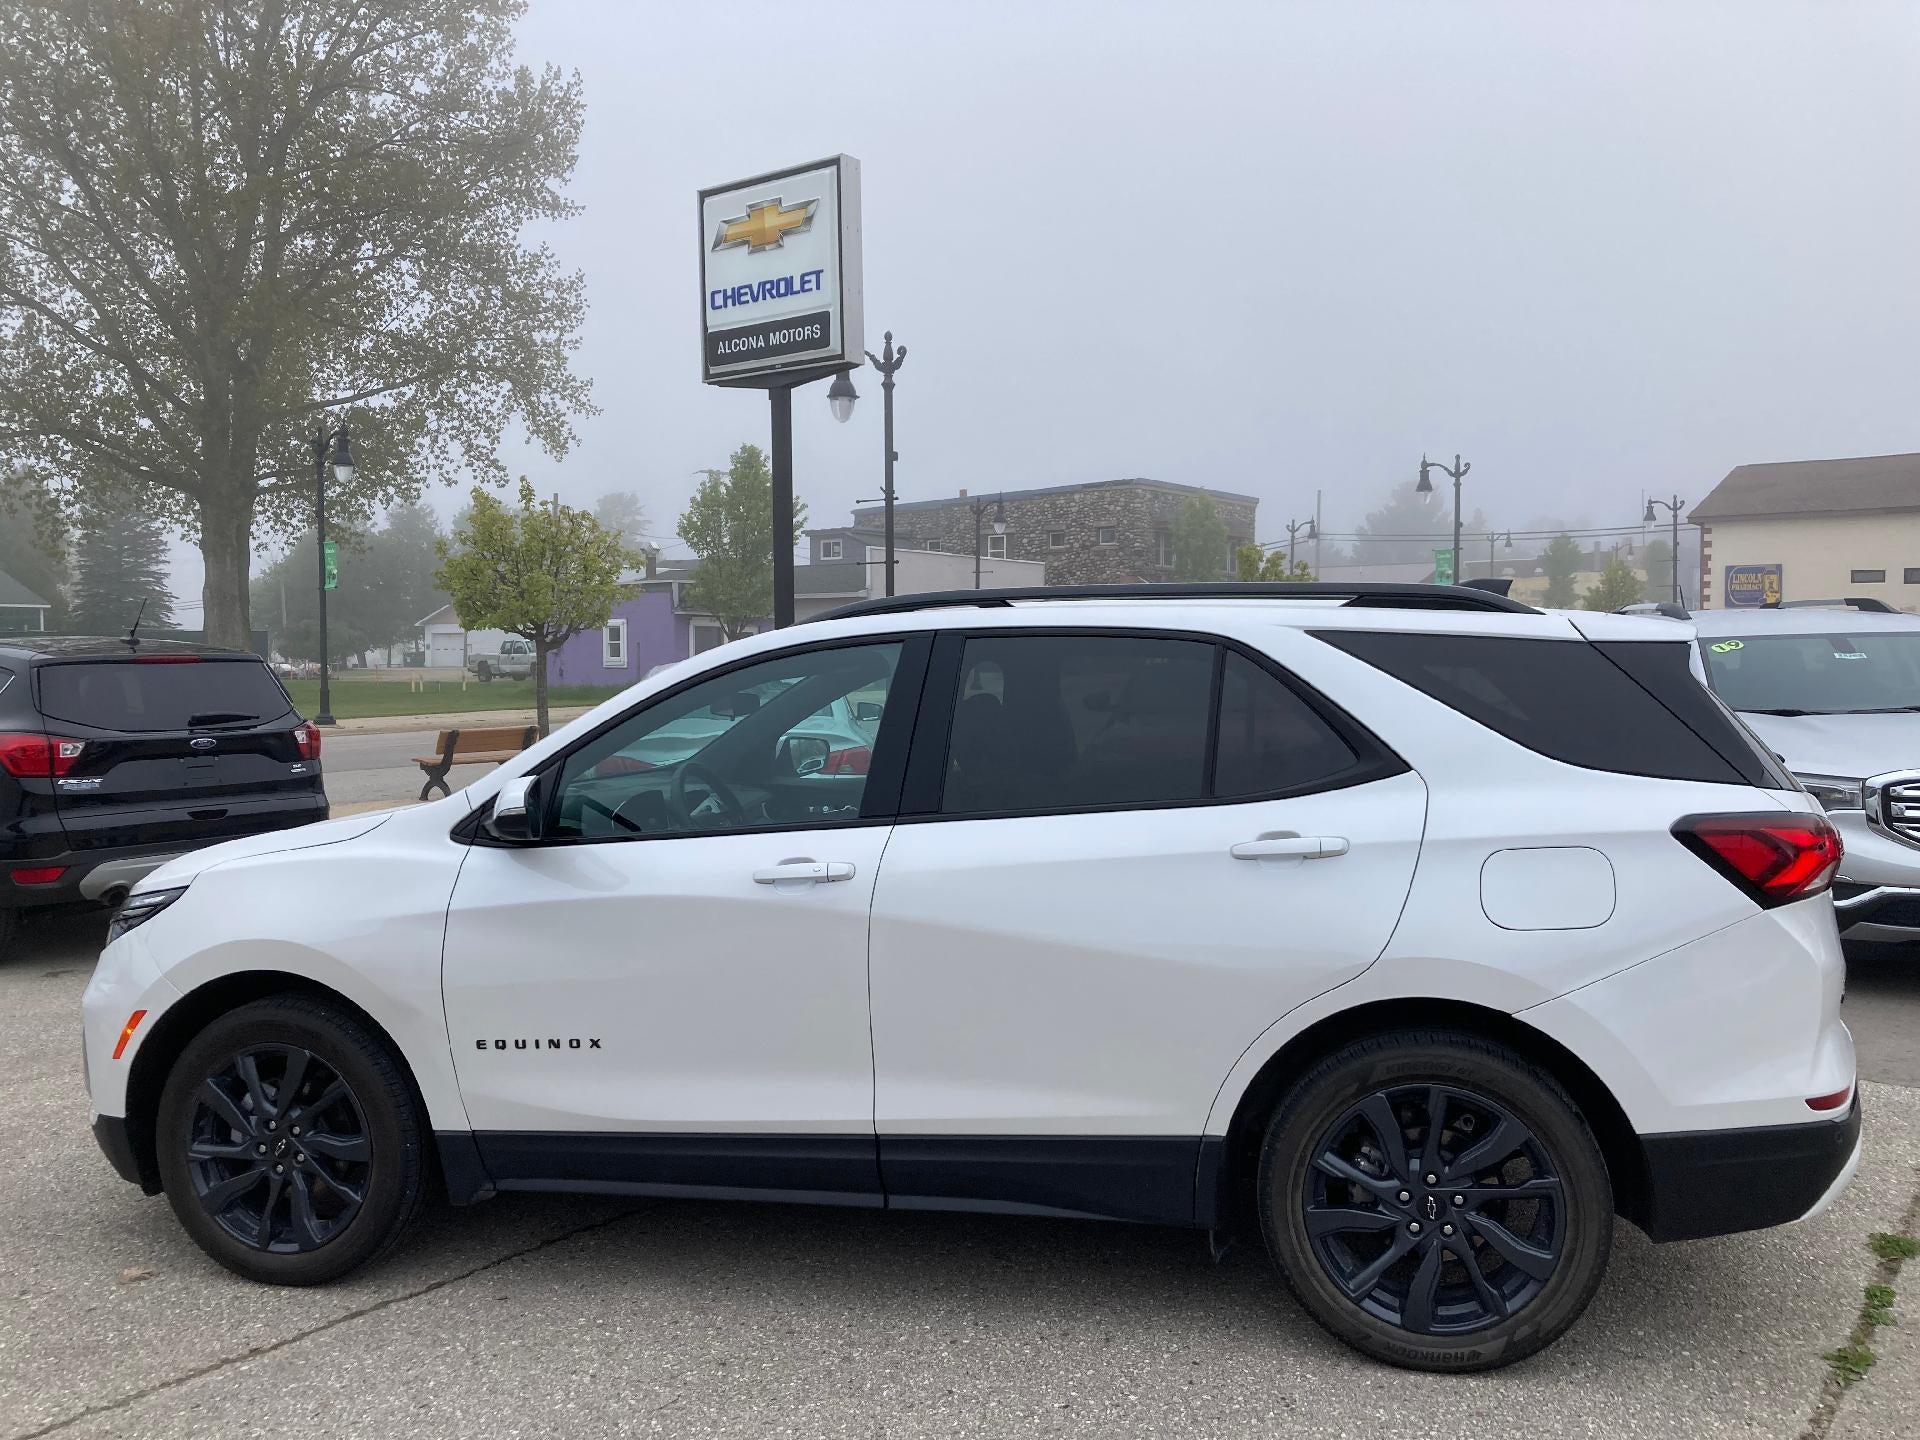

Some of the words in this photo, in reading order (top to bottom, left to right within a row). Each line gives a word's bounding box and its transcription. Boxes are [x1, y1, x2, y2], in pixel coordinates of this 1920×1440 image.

[710, 269, 824, 310] CHEVROLET
[717, 335, 766, 354] ALCONA
[769, 323, 821, 346] MOTORS
[1733, 573, 1762, 583] LINCOLN
[1731, 583, 1762, 592] PHARMACY
[475, 1038, 602, 1050] EQUINOX
